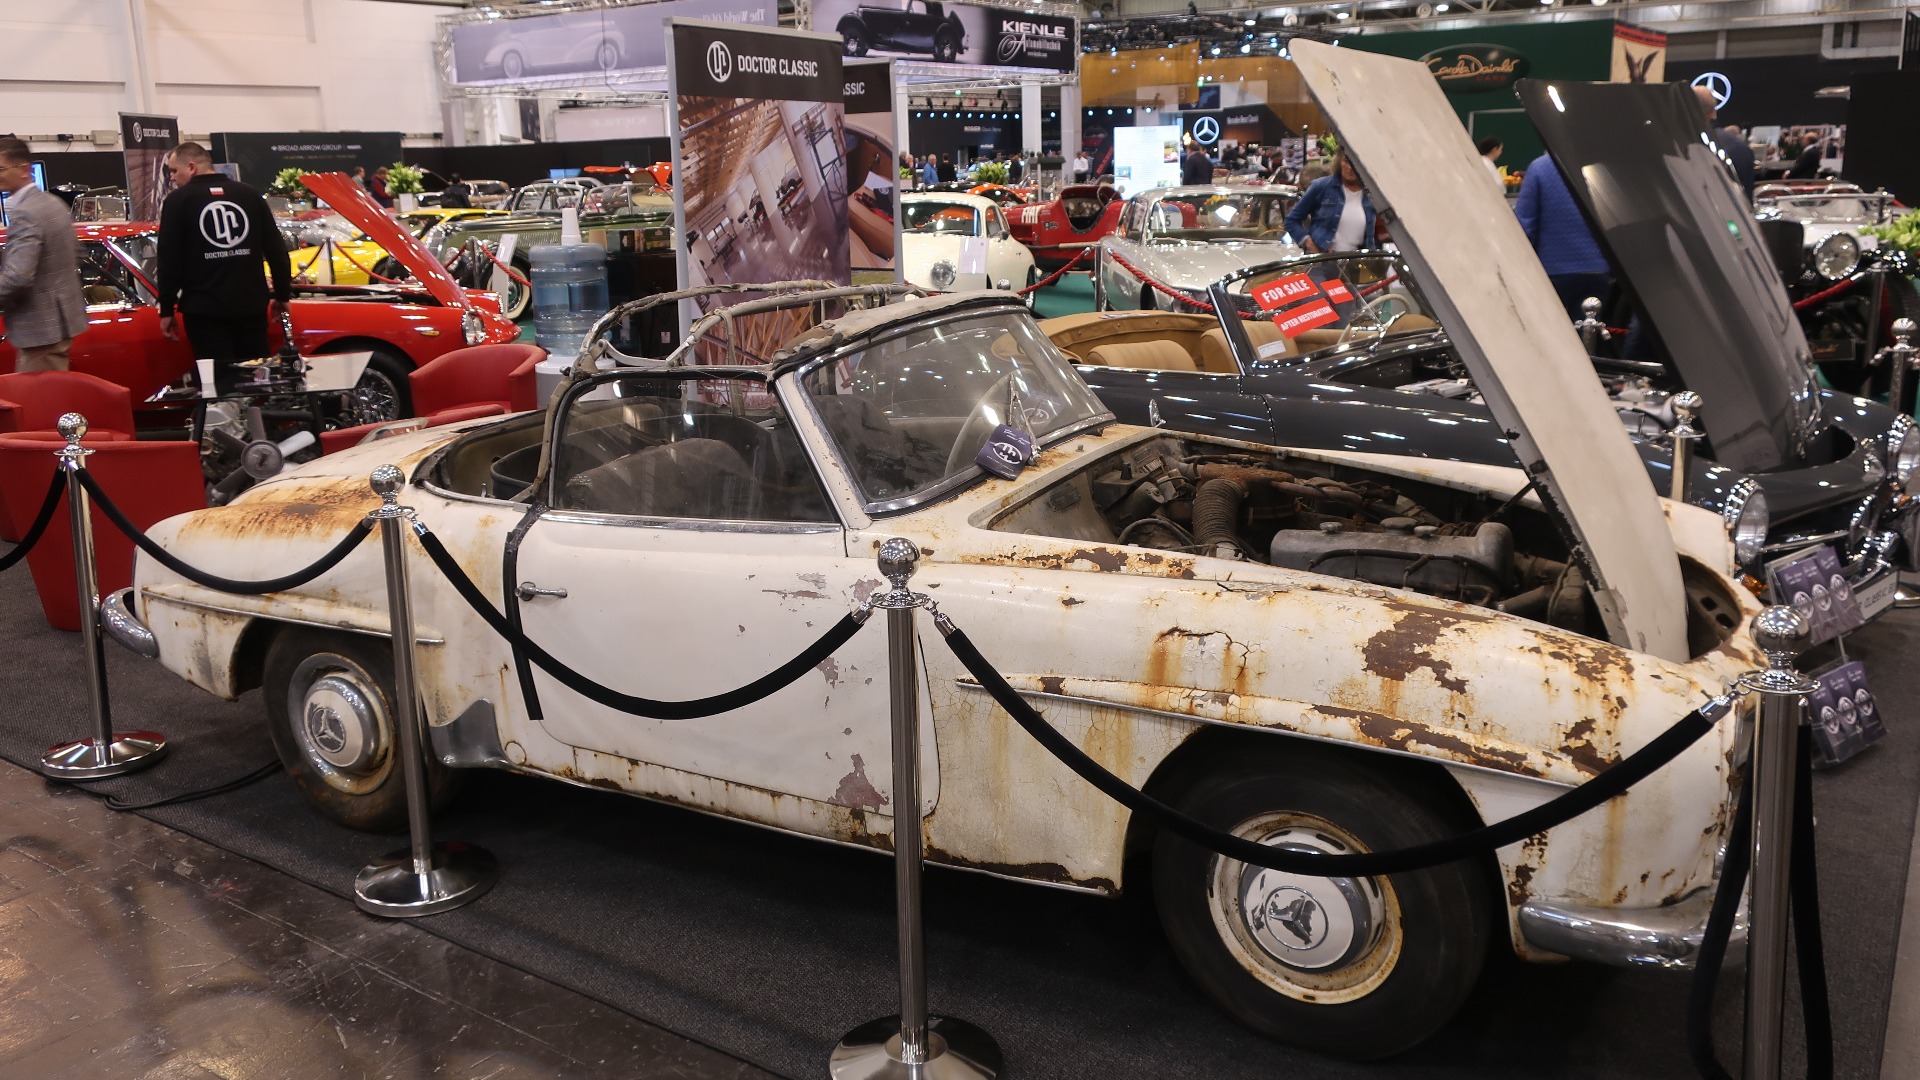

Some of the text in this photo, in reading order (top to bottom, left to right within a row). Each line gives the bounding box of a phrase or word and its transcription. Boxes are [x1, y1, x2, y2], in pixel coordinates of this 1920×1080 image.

[1002, 20, 1065, 38] KIENLE
[737, 54, 819, 77] DOCTOR CLASSIC
[277, 144, 299, 152] BROAD
[1021, 205, 1046, 224] FIAT
[204, 251, 228, 260] DOCTOR
[1261, 279, 1311, 303] FOR SALE
[1280, 305, 1333, 331] AFTER RESTORATION
